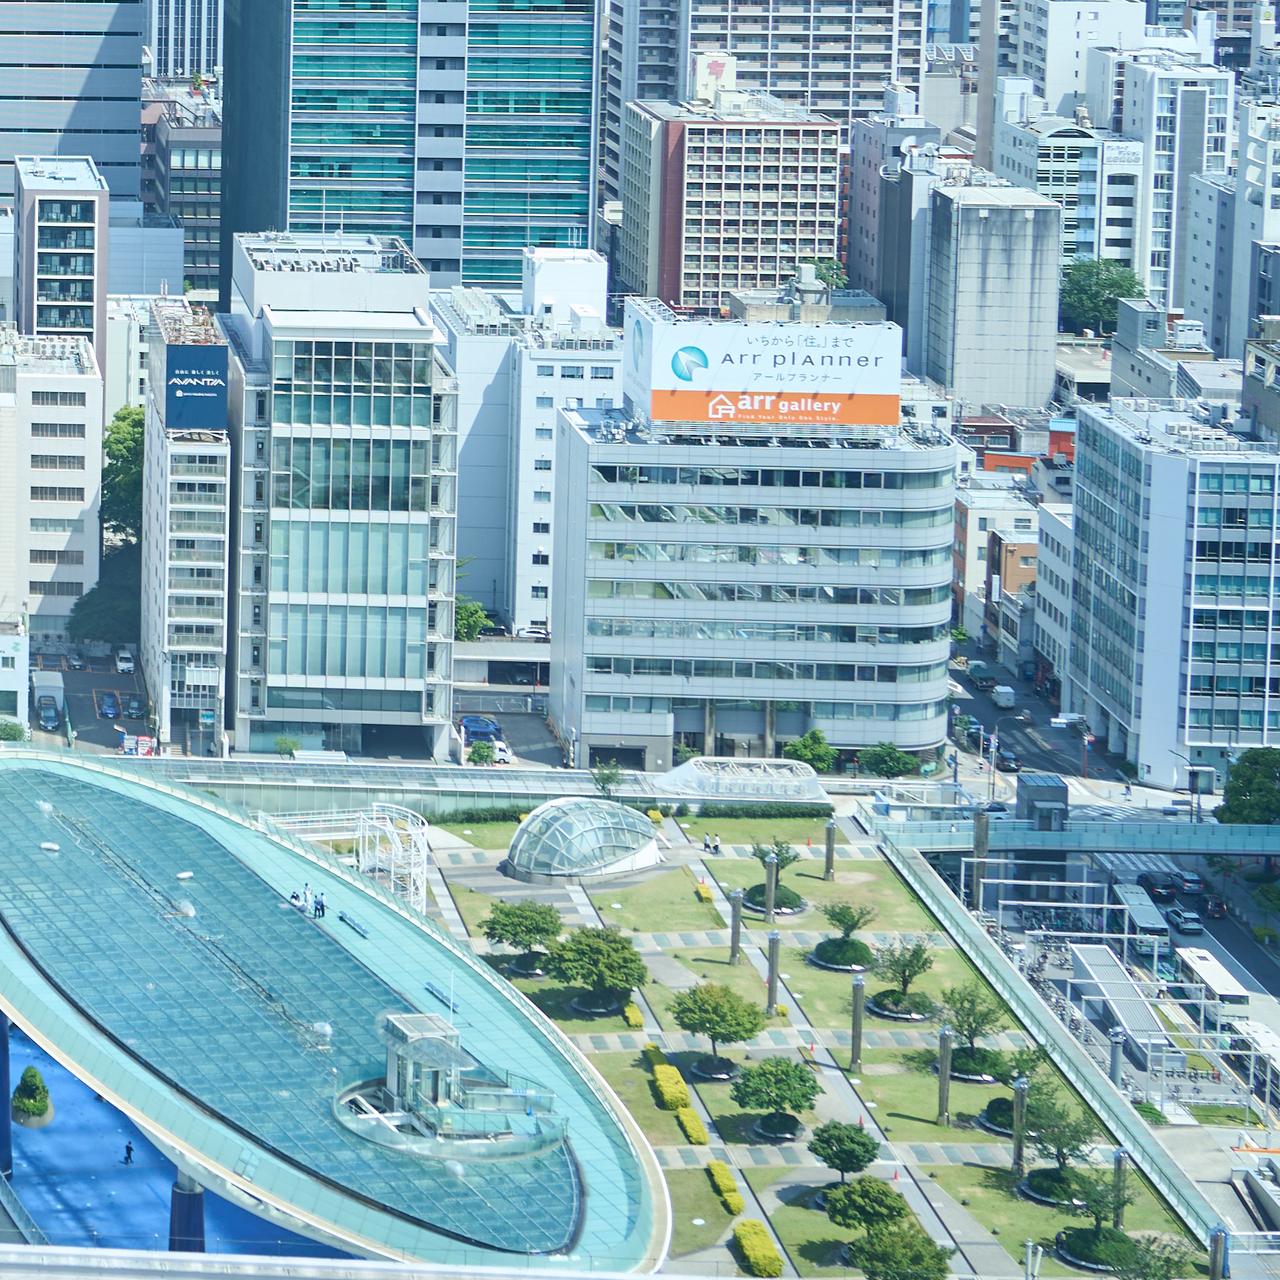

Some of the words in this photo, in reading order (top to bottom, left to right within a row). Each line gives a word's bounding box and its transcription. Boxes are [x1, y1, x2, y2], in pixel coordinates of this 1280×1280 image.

[168, 378, 225, 386] AVANTIA
[753, 372, 842, 382] アールプランナー
[737, 394, 776, 410] arr
[779, 398, 841, 413] gallery
